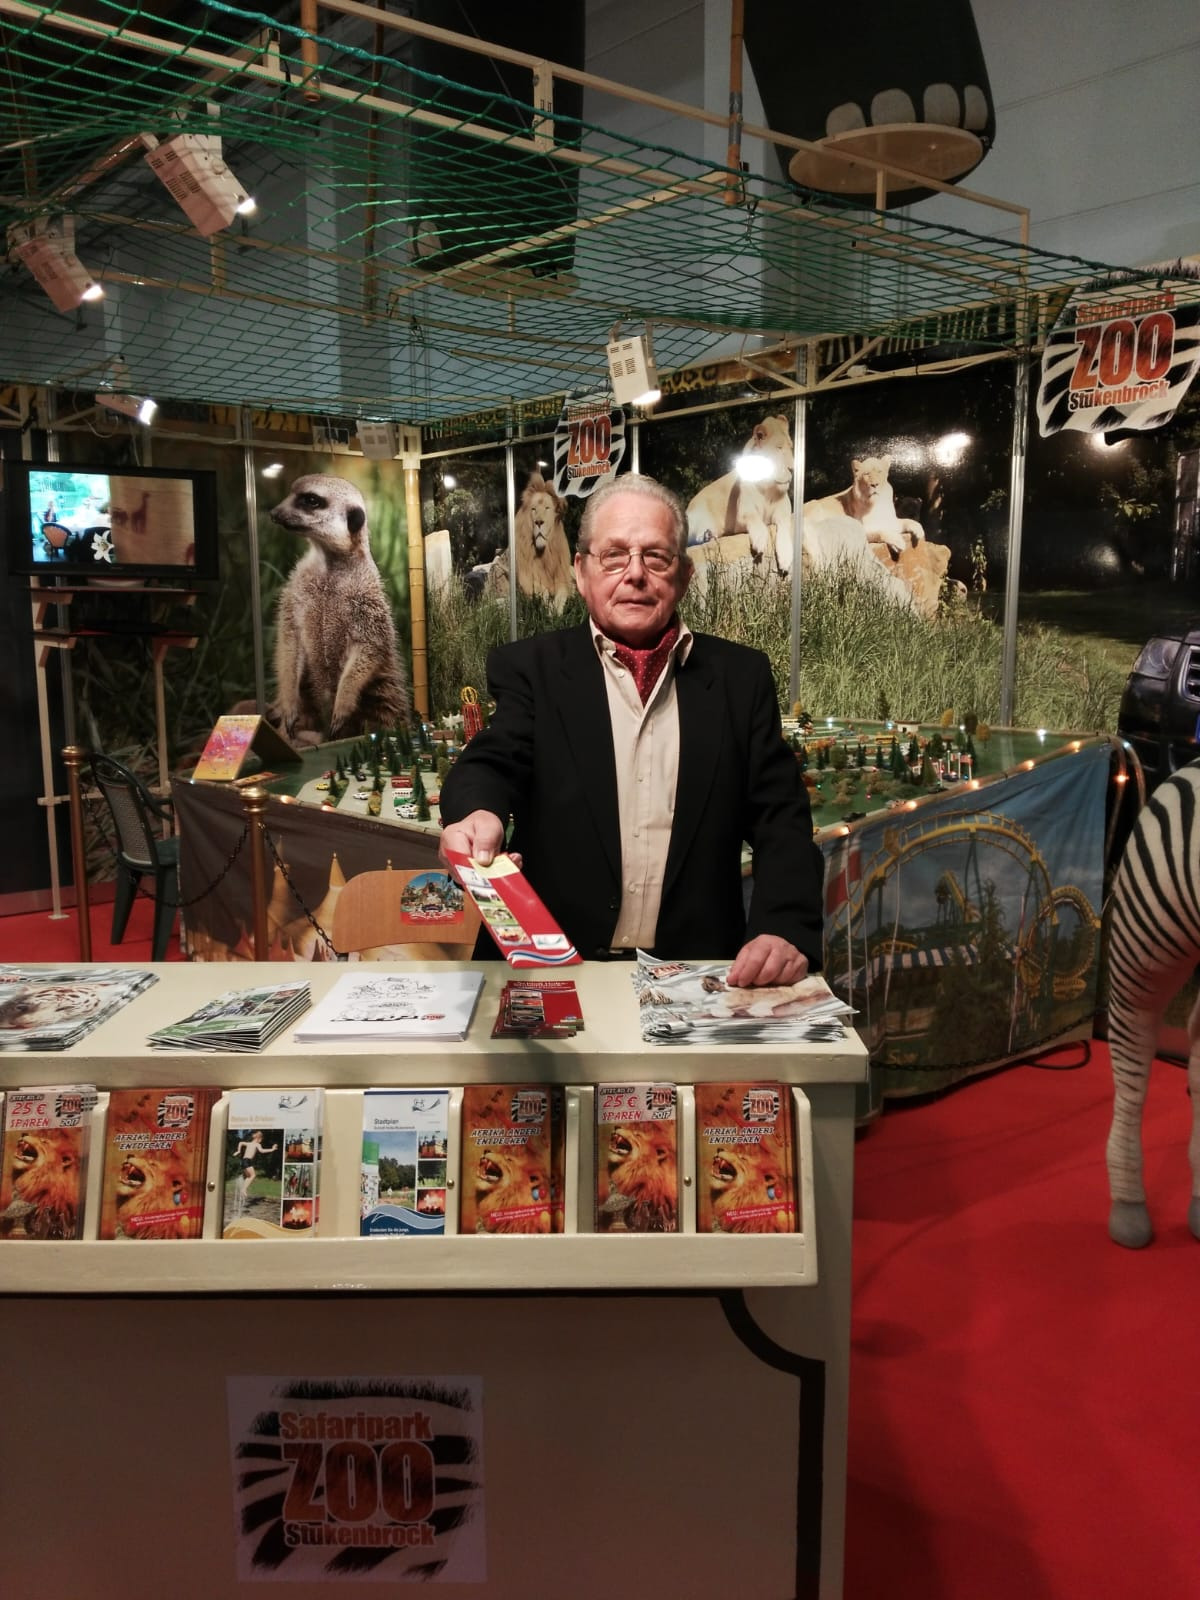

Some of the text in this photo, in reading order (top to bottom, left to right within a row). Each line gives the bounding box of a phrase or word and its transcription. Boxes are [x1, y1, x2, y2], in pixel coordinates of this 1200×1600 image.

[1070, 312, 1174, 390] ZOO
[1069, 379, 1169, 411] Stukenbrock
[568, 415, 611, 465] ZOO
[603, 1094, 638, 1108] 25 €
[12, 1102, 47, 1115] 25 €
[602, 1110, 641, 1120] SPAREN
[652, 1111, 671, 1119] 2017
[10, 1118, 49, 1128] SPAREN
[60, 1118, 80, 1126] 2017
[114, 1133, 150, 1142] AFRIKA
[471, 1128, 505, 1138] AFRIKA
[703, 1128, 737, 1137] AFRIKA
[281, 1411, 432, 1442] Safaripark
[282, 1441, 434, 1522] ZOO
[285, 1523, 435, 1547] Stukenbrock
